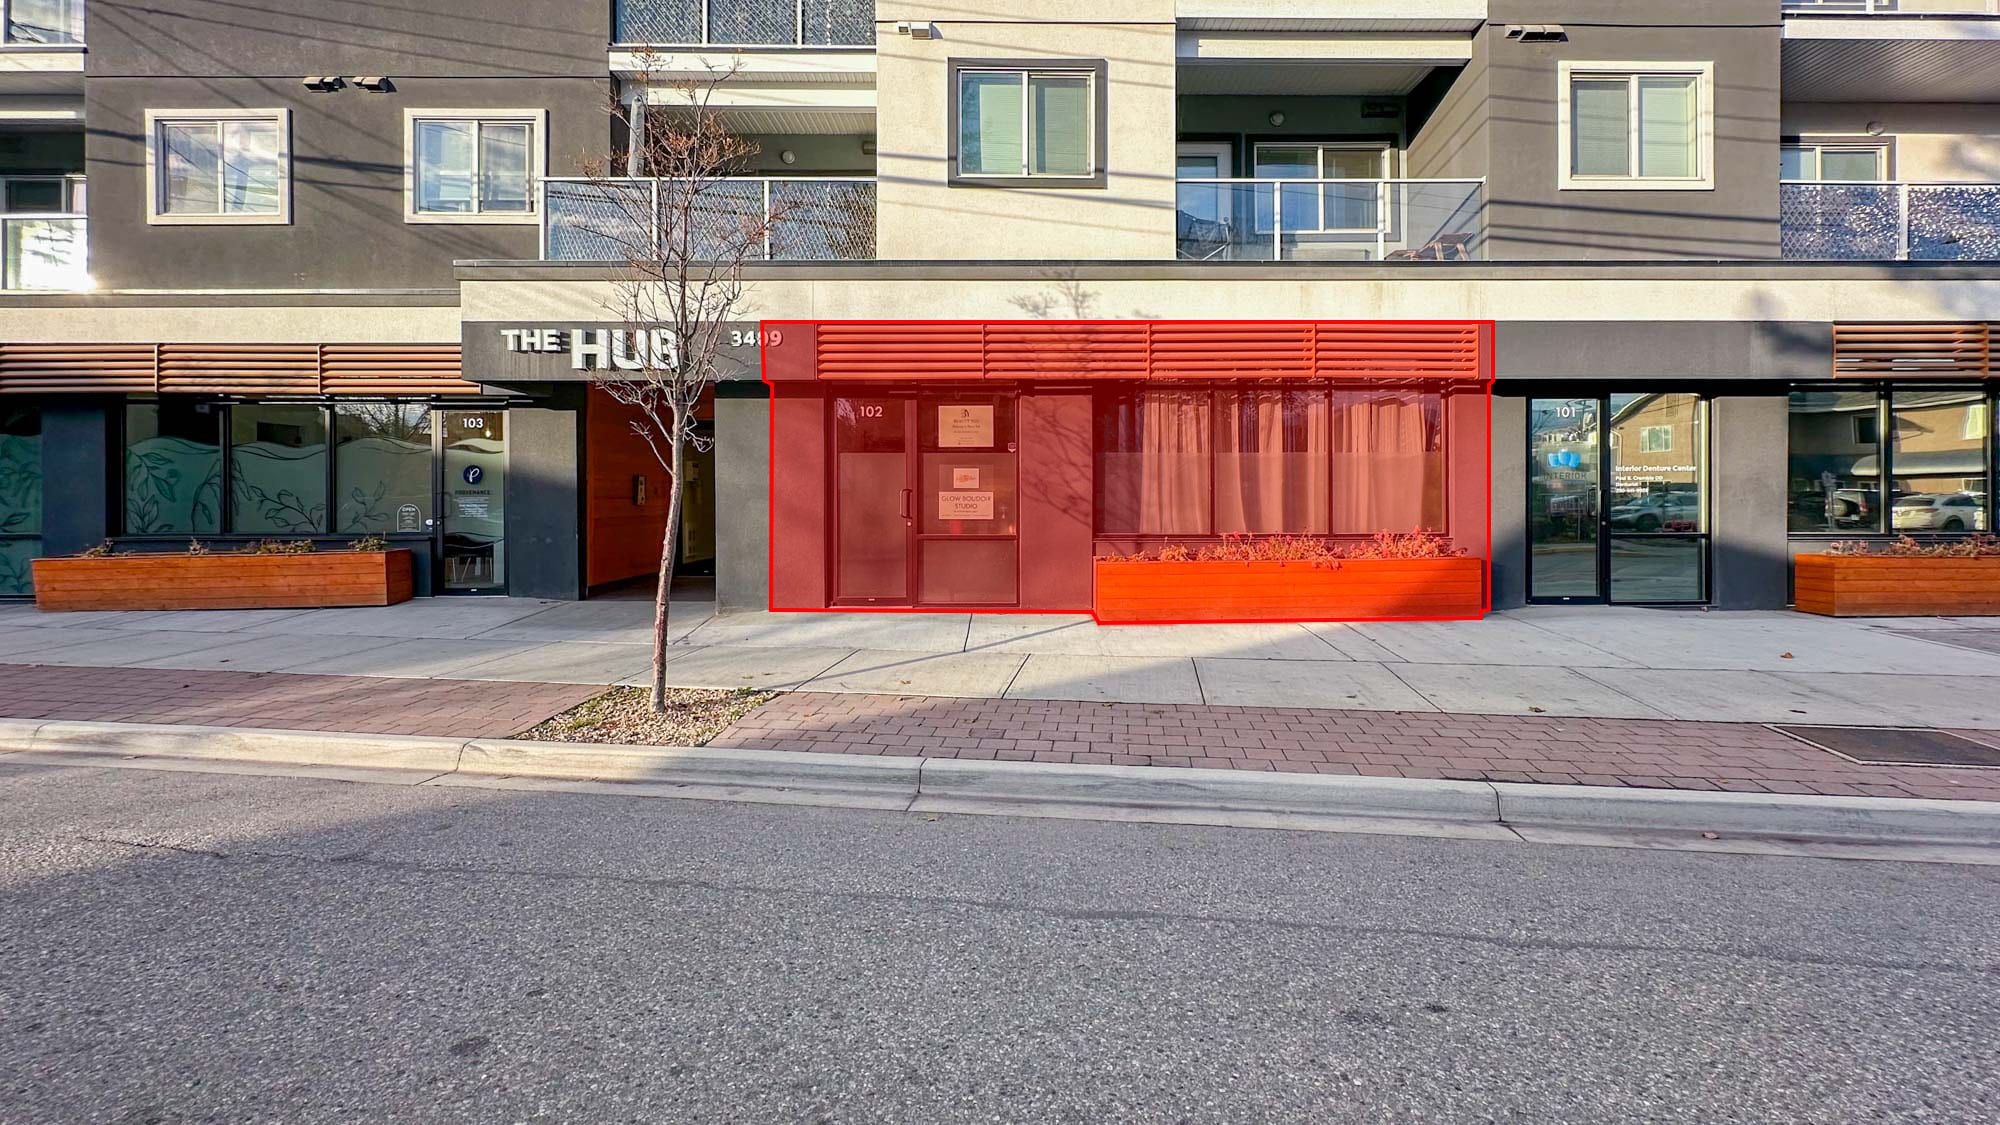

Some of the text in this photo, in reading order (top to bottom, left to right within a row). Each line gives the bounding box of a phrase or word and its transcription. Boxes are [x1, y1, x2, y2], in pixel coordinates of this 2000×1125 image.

[501, 328, 680, 370] THE HUB
[860, 405, 883, 418] 102
[1556, 406, 1576, 418] 101
[463, 417, 484, 429] 103
